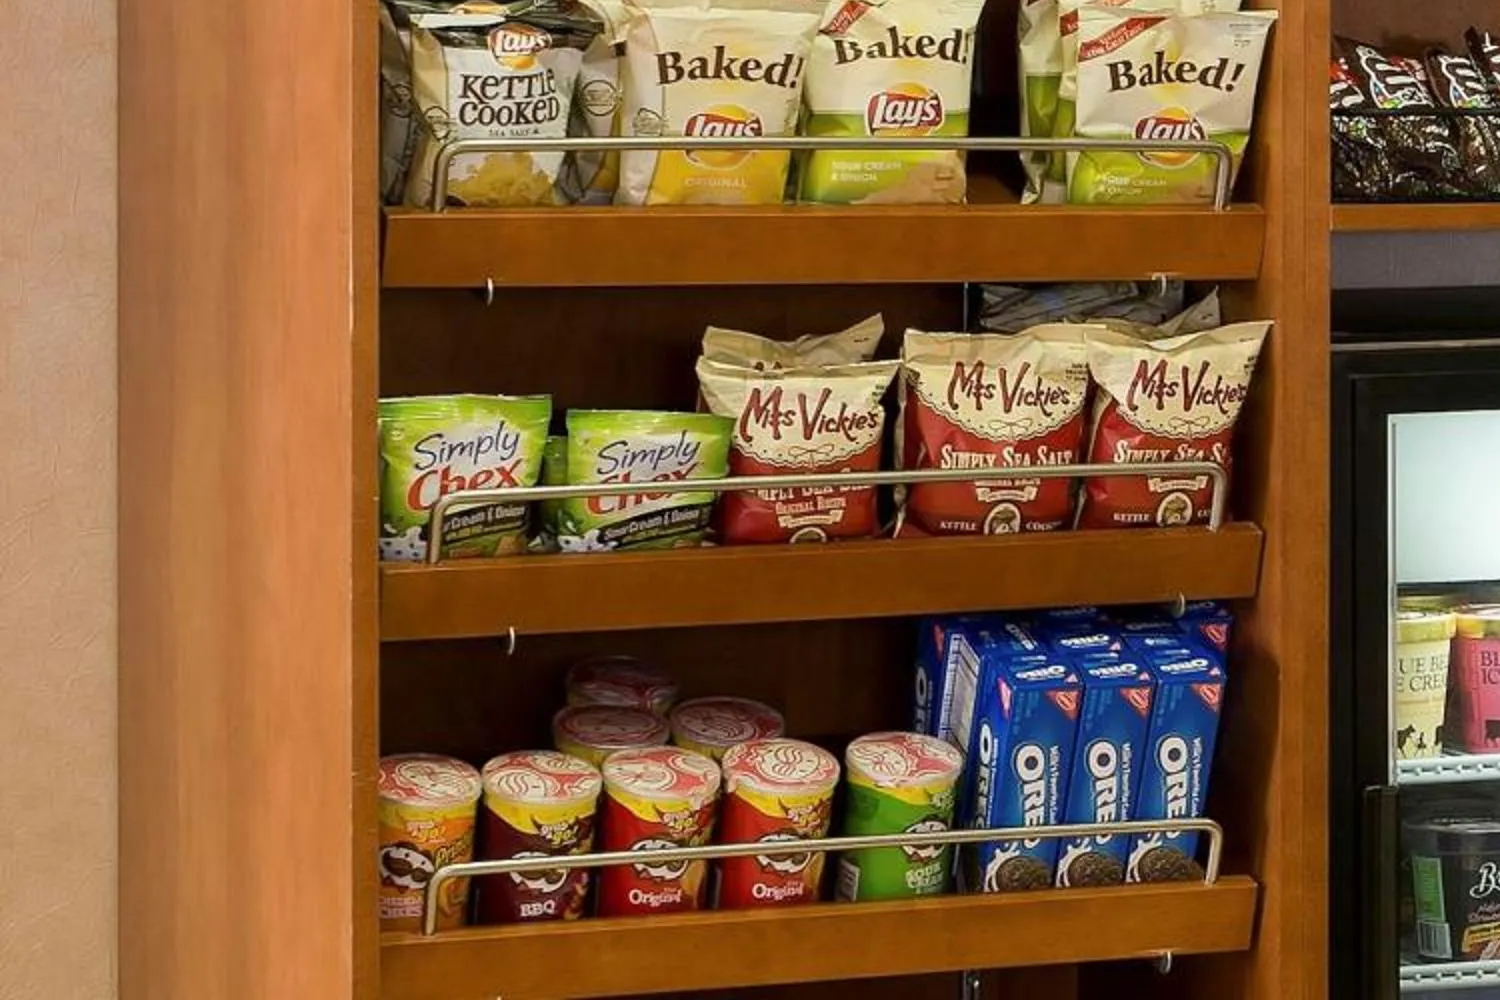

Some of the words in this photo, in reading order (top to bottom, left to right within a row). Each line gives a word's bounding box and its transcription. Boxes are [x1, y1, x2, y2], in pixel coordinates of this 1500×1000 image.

[656, 46, 804, 89] Baked!
[834, 26, 973, 65] Baked!
[1106, 51, 1246, 92] Baked!
[999, 361, 1071, 416] Vickie's
[1181, 360, 1249, 416] Vickie's
[797, 387, 879, 442] Vickie's
[413, 420, 520, 471] Simply
[597, 430, 700, 476] Simply
[407, 459, 523, 513] Chex
[520, 899, 557, 918] BBQ
[629, 888, 682, 907] Original
[752, 880, 803, 900] Original
